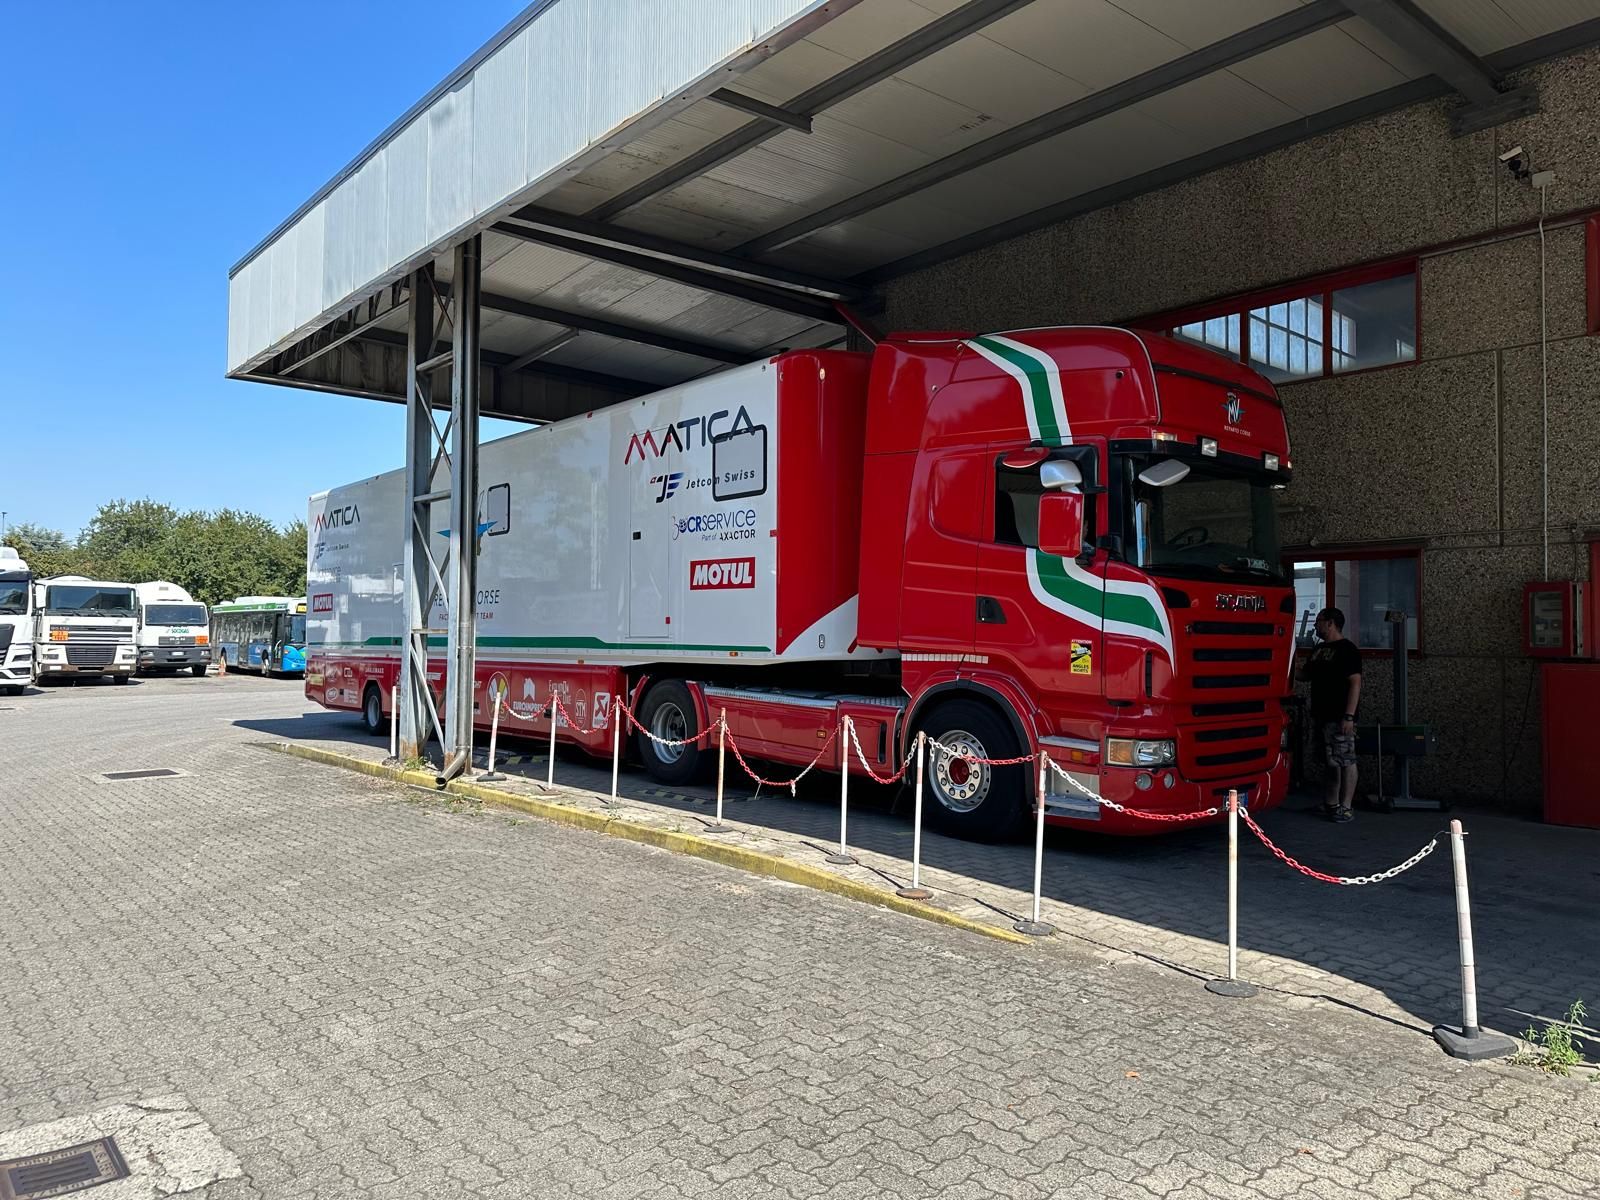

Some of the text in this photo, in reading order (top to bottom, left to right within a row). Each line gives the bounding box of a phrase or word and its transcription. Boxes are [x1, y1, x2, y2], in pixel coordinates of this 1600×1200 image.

[624, 405, 755, 465] MATICA
[724, 469, 755, 483] Swiss
[314, 504, 361, 533] MATICA
[693, 562, 753, 586] MOTUL
[314, 595, 333, 611] MOTUL
[477, 589, 500, 605] ORSE
[1215, 593, 1266, 612] SCANIA
[480, 611, 494, 620] TEAM
